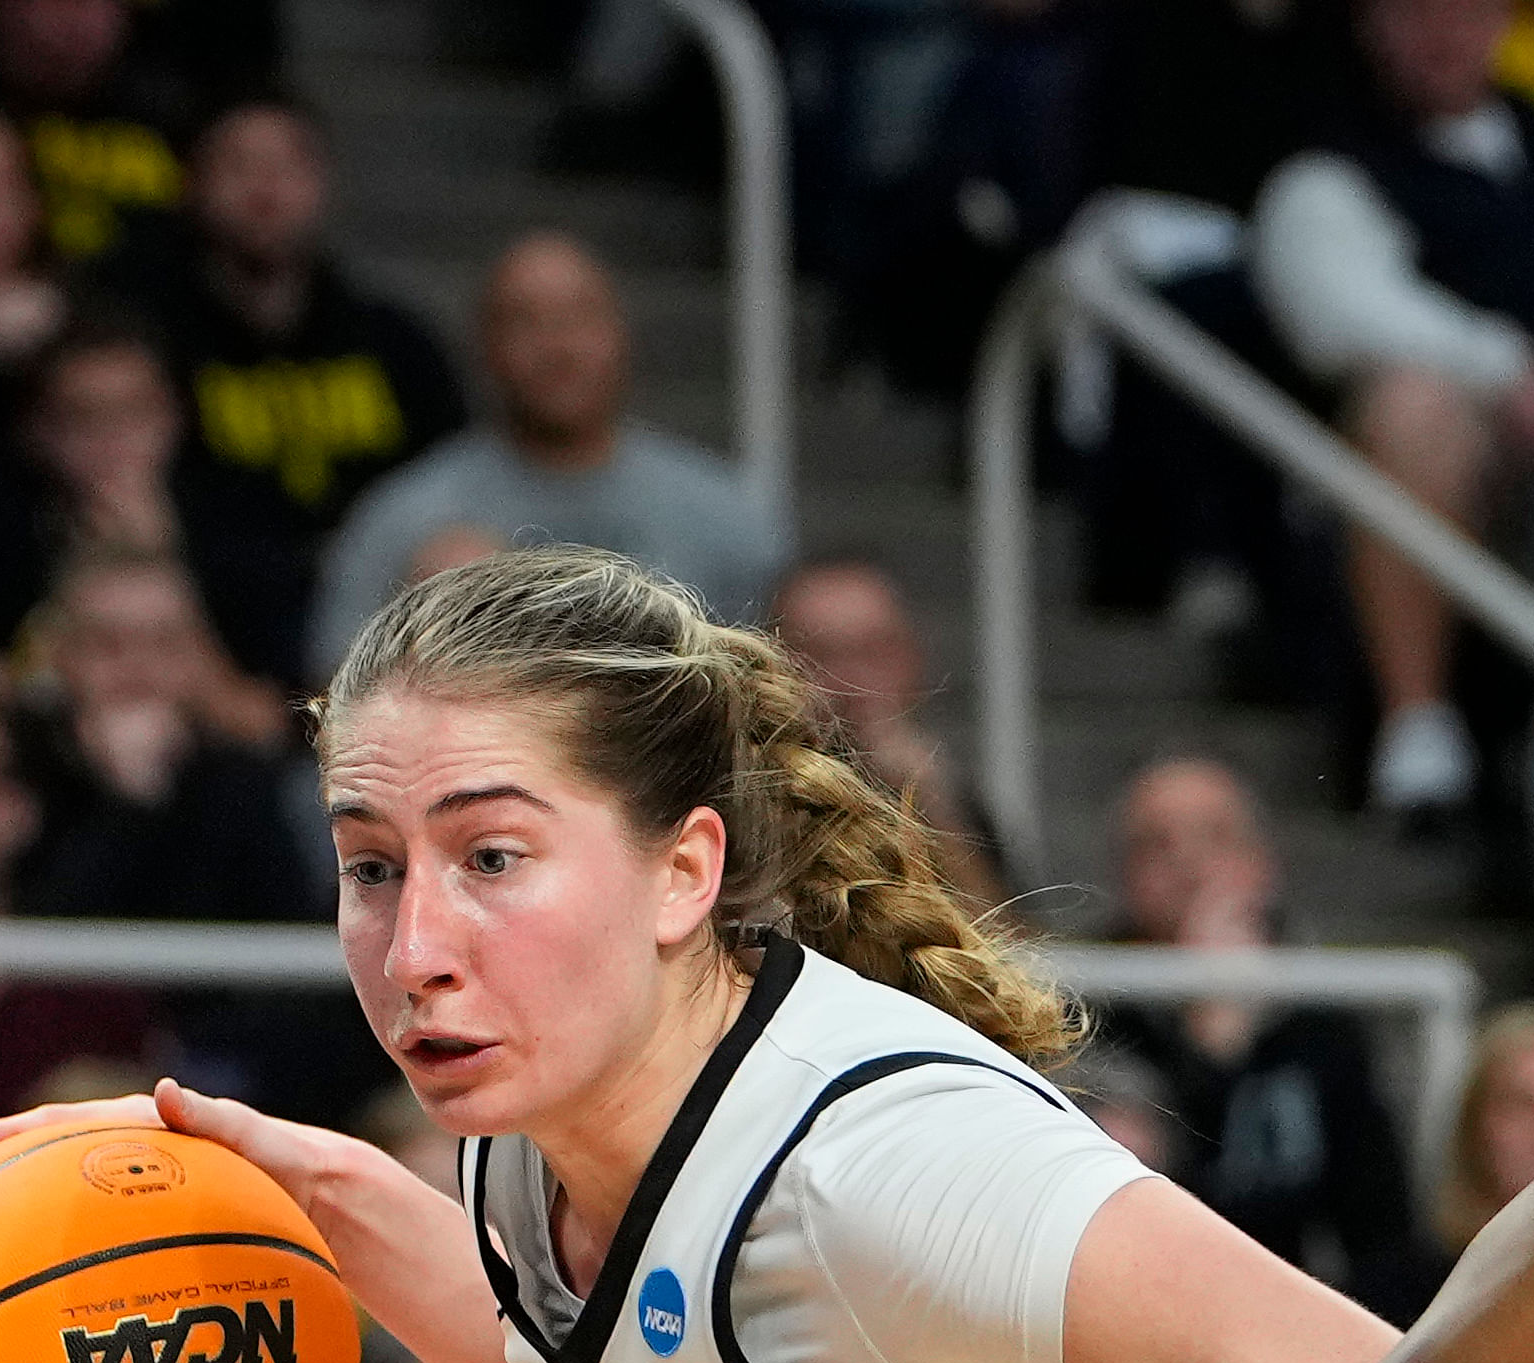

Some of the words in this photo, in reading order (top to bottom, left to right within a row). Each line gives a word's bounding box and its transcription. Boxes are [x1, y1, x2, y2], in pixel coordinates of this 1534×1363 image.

[134, 1284, 201, 1308] GAME
[204, 1275, 291, 1303] OFFICIAL
[59, 1300, 126, 1319] BALL
[643, 1305, 683, 1339] NCAA
